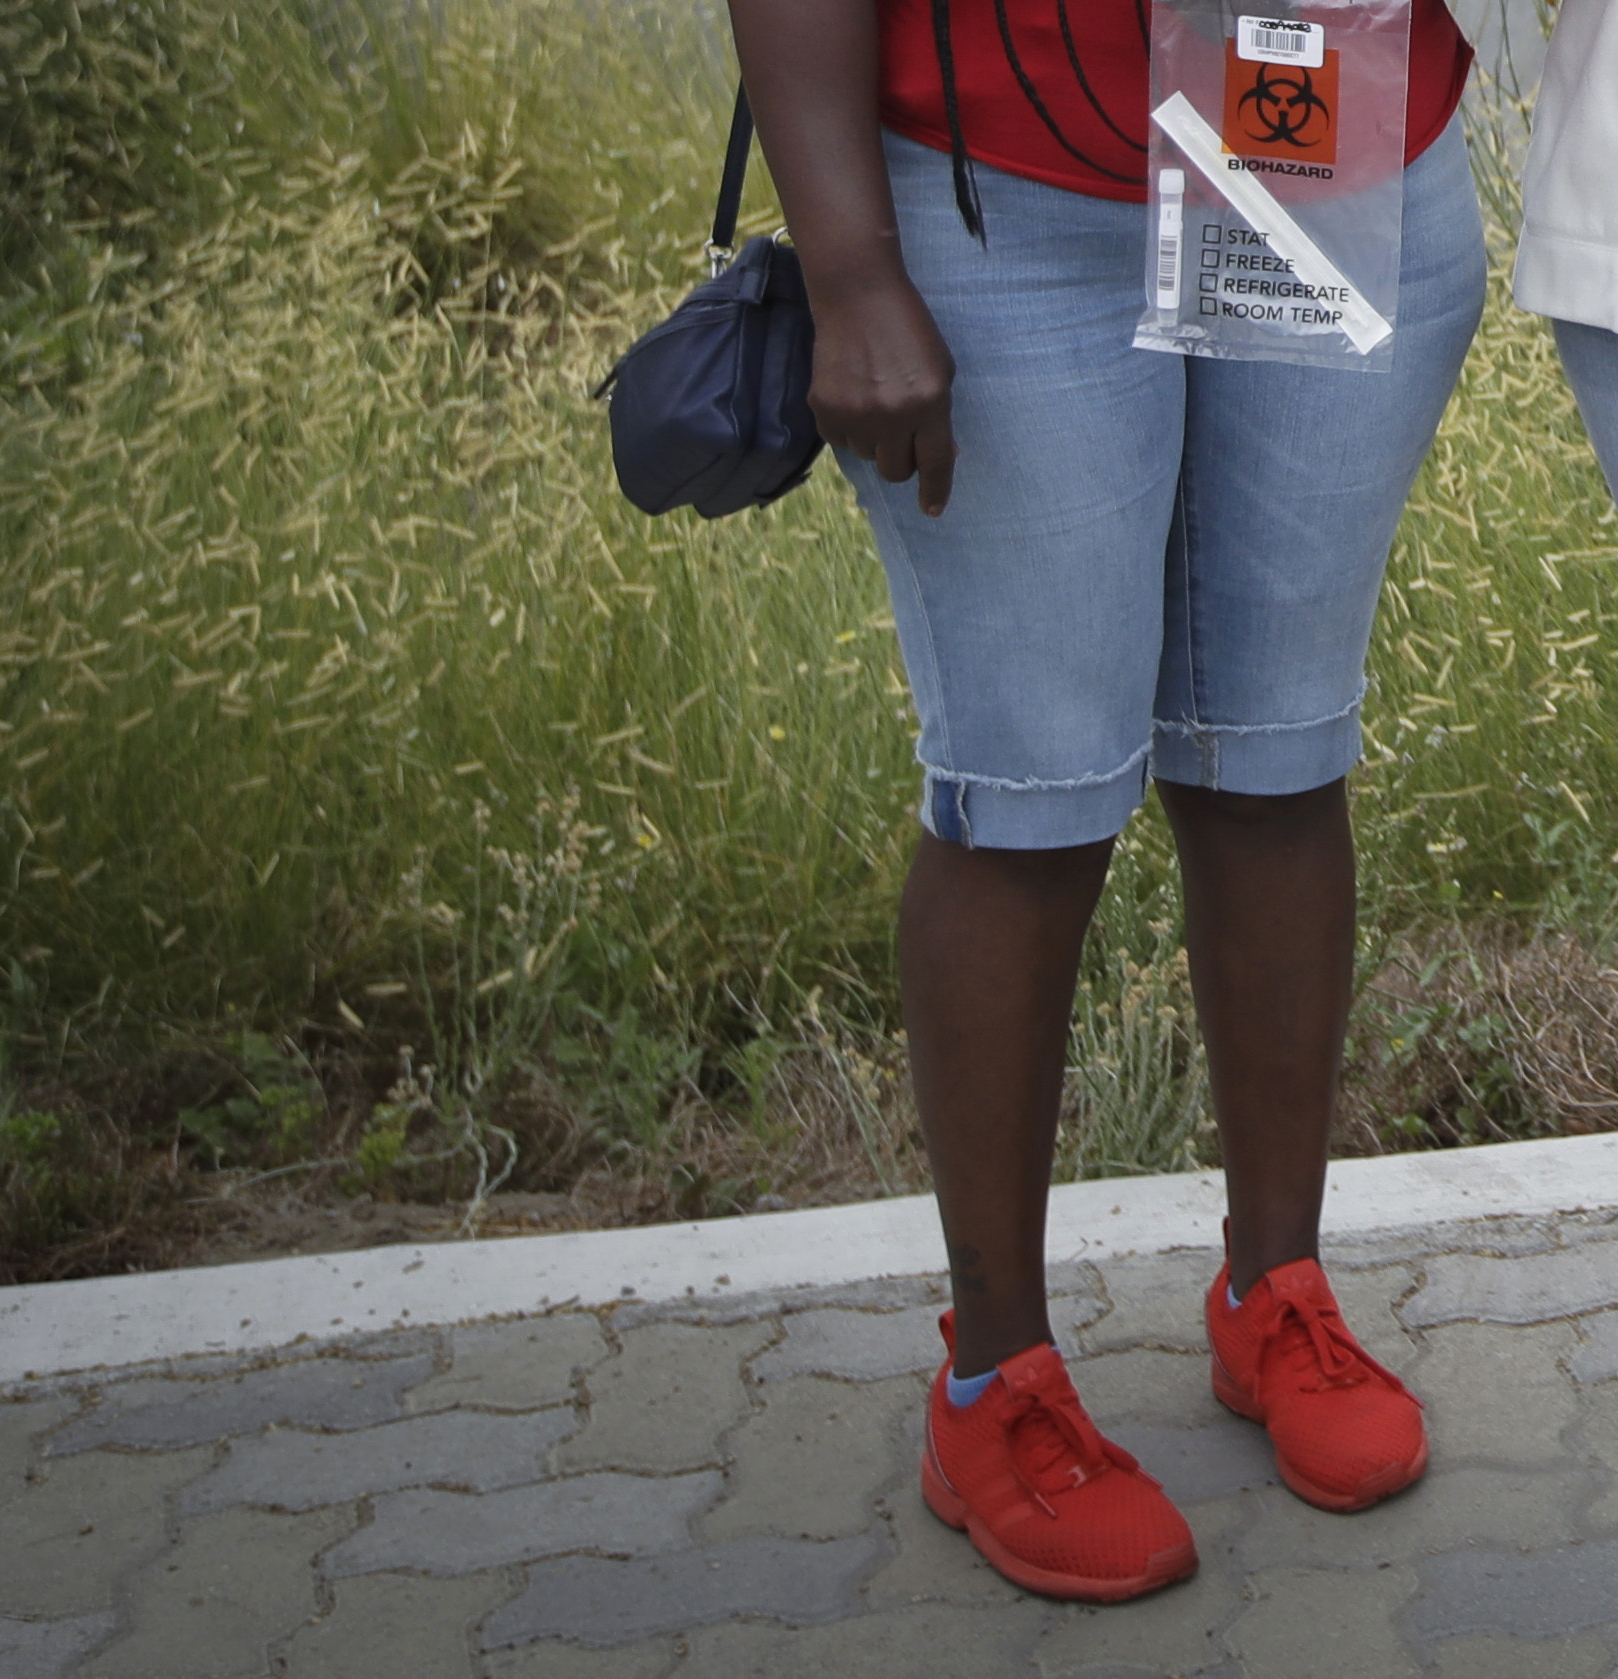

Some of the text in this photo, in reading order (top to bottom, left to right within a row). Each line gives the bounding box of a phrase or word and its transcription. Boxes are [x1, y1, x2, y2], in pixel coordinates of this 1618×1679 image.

[1227, 159, 1334, 180] BIOHAZARD
[1227, 229, 1271, 247] STAT
[1226, 254, 1295, 274] FREEZE
[1223, 277, 1350, 302] REFRIGERATE
[1222, 302, 1343, 325] ROOM TEMP
